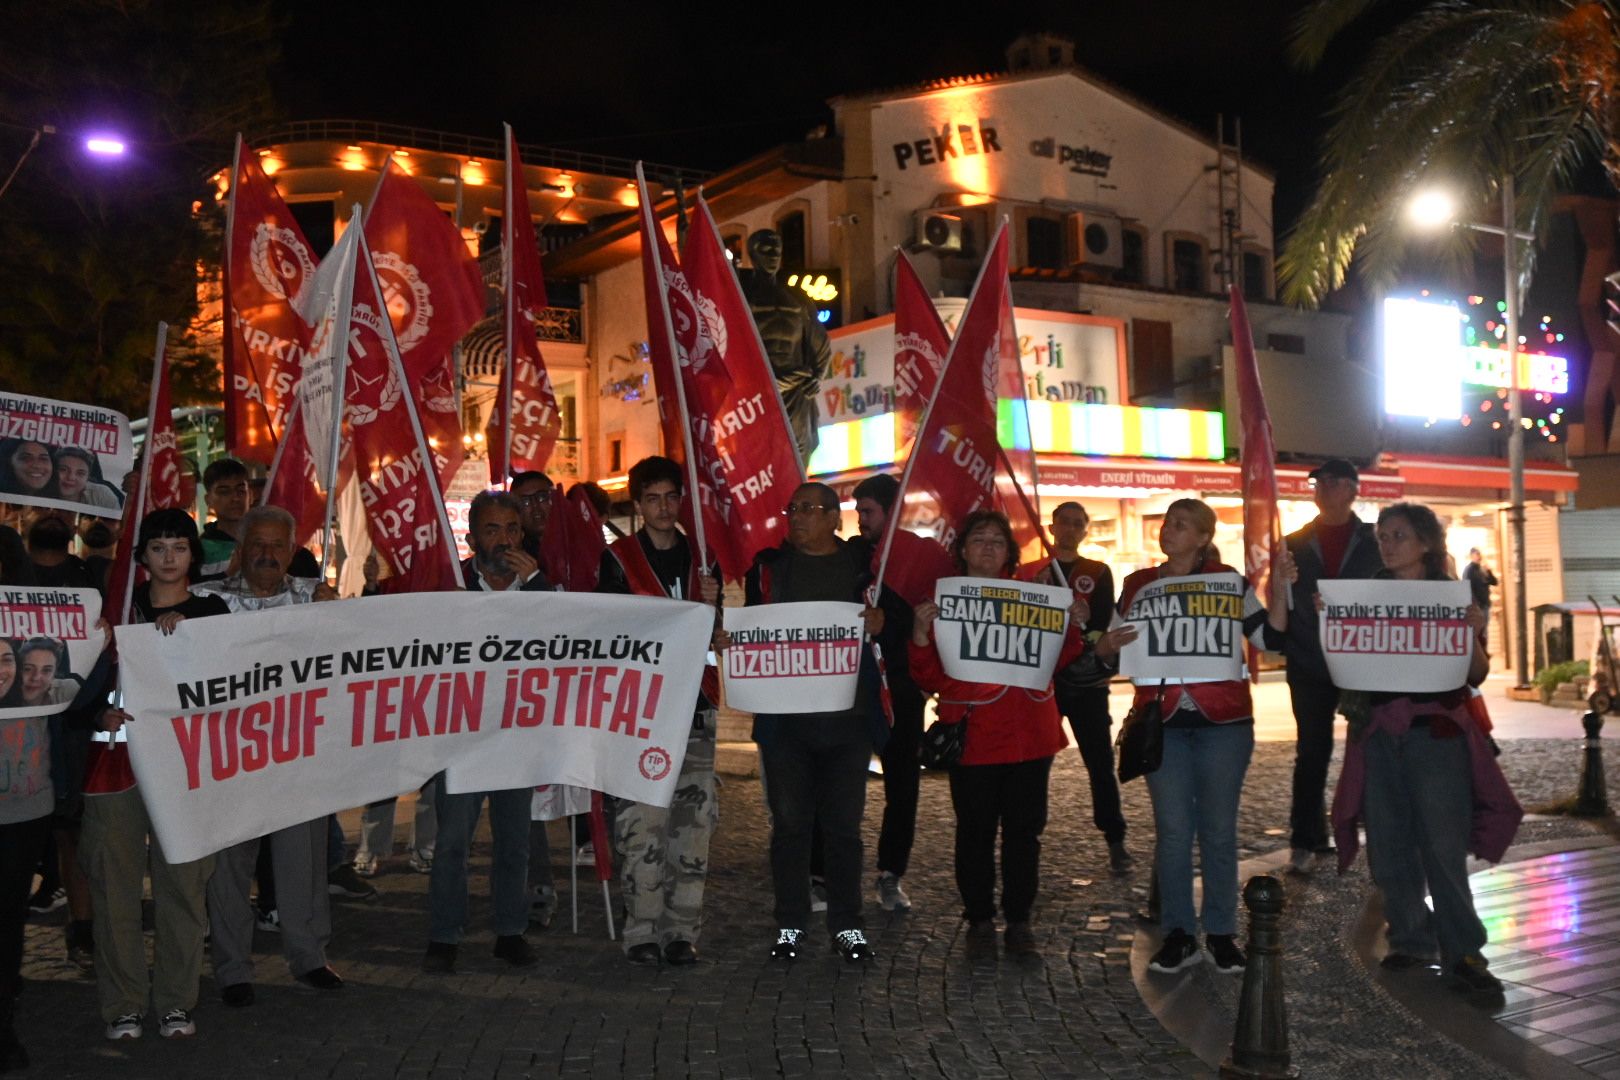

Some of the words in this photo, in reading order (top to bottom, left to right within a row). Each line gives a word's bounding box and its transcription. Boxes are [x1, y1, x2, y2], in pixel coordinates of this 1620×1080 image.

[893, 124, 1002, 170] PEKER
[51, 405, 67, 419] VE
[4, 592, 23, 605] VE
[1022, 591, 1049, 605] YOKSA
[1207, 582, 1237, 593] YOKSA
[941, 597, 996, 623] SANA
[1001, 601, 1064, 633] HUZUR
[1128, 595, 1183, 620] SANA
[1187, 594, 1243, 619] HUZU
[1385, 605, 1404, 619] VE
[786, 628, 802, 642] VE
[965, 622, 1041, 665] YOK!
[1151, 617, 1231, 654] YOK!
[1328, 620, 1465, 654] ÖZGÜRLÜK!
[177, 661, 283, 709] NEHİR
[291, 655, 334, 680] VE
[340, 638, 472, 676] NEVİN'E
[479, 634, 663, 665] ÖZGÜRLÜK!
[730, 642, 857, 677] ÖZGÜRLÜK!
[171, 687, 328, 790] YUSUF
[346, 670, 486, 747] TEKİN
[501, 665, 664, 739] İSTİFA!
